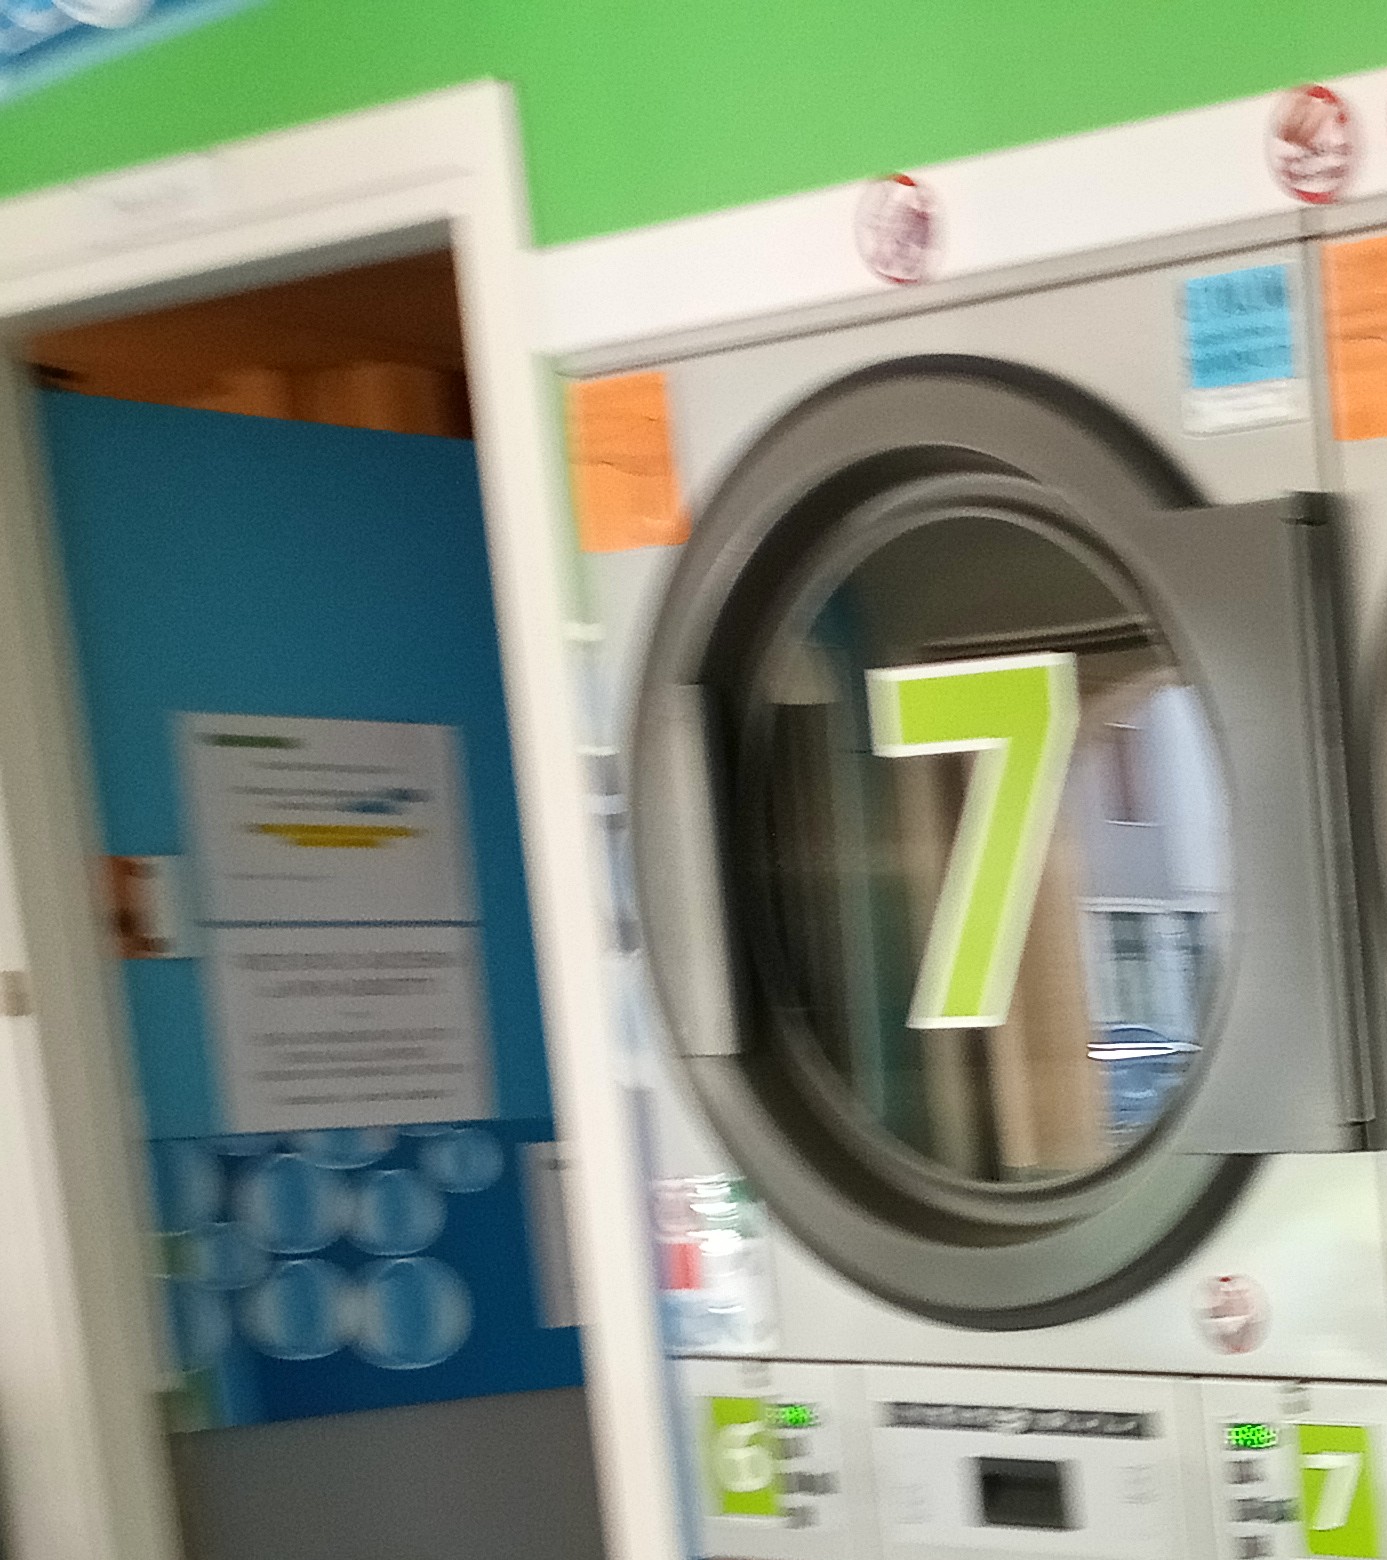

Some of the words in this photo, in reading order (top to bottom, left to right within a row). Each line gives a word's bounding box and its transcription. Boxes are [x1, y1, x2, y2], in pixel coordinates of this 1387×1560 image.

[865, 652, 1081, 1029] 7
[714, 1420, 774, 1492] 6
[1301, 1451, 1364, 1531] 7
